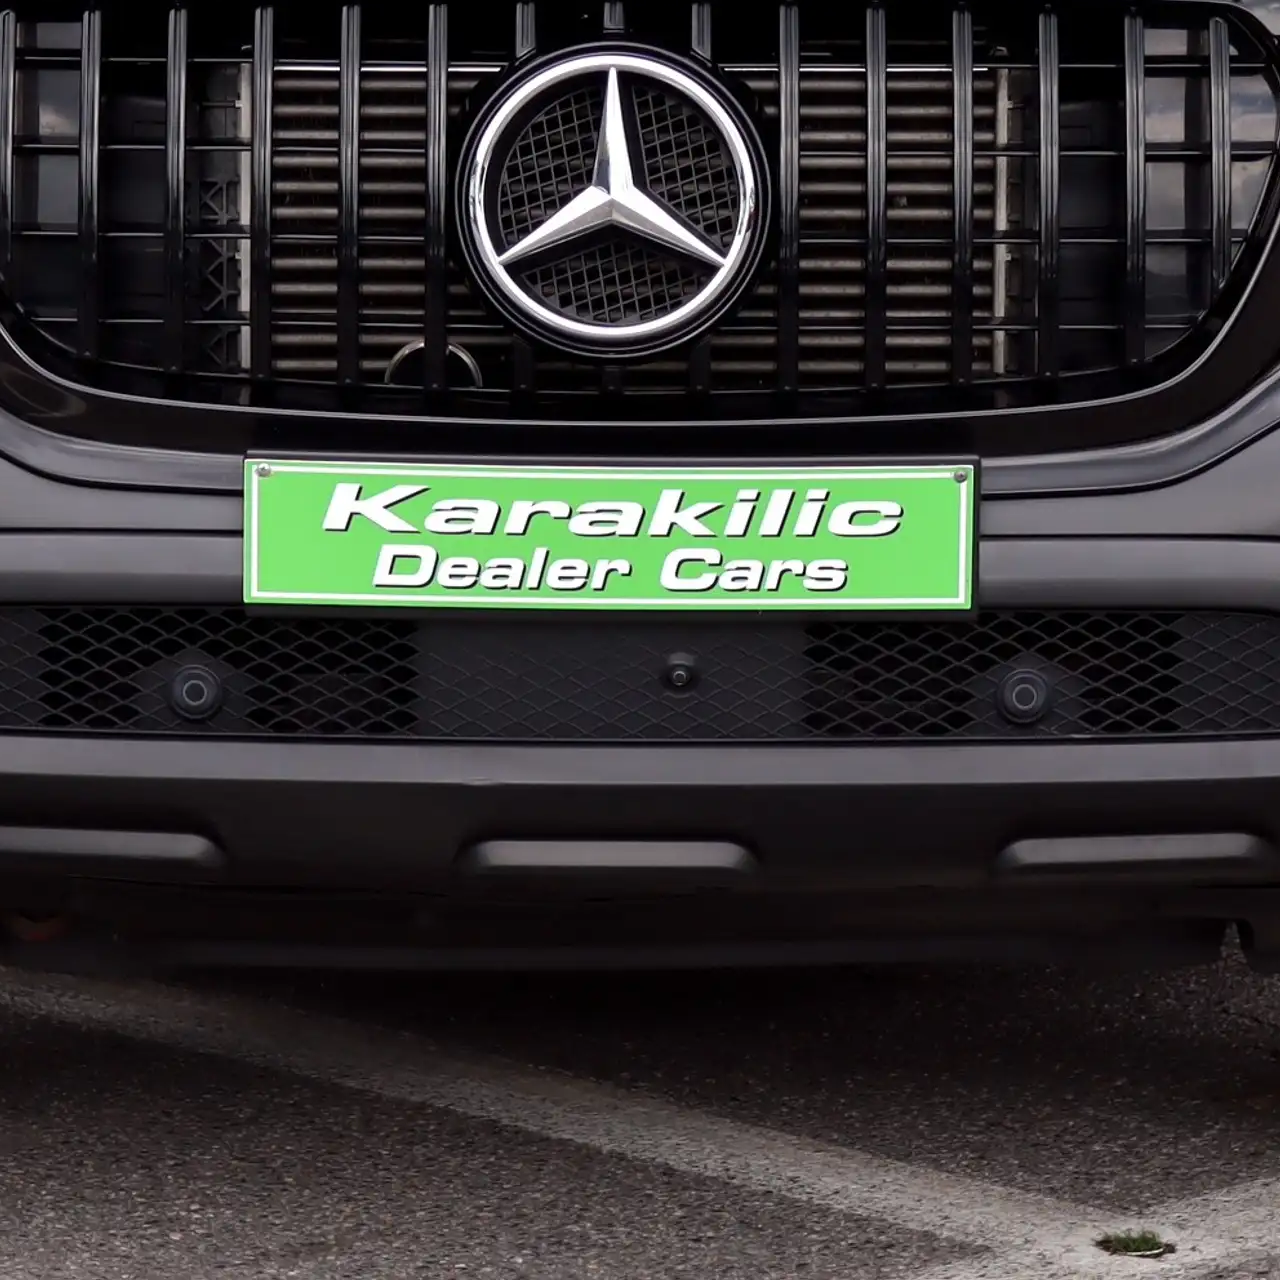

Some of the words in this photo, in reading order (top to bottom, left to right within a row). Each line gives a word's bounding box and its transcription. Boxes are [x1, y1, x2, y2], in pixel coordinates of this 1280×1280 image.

[320, 481, 905, 538] Karakilic
[372, 543, 632, 592] Dealer
[658, 547, 850, 593] Cars
